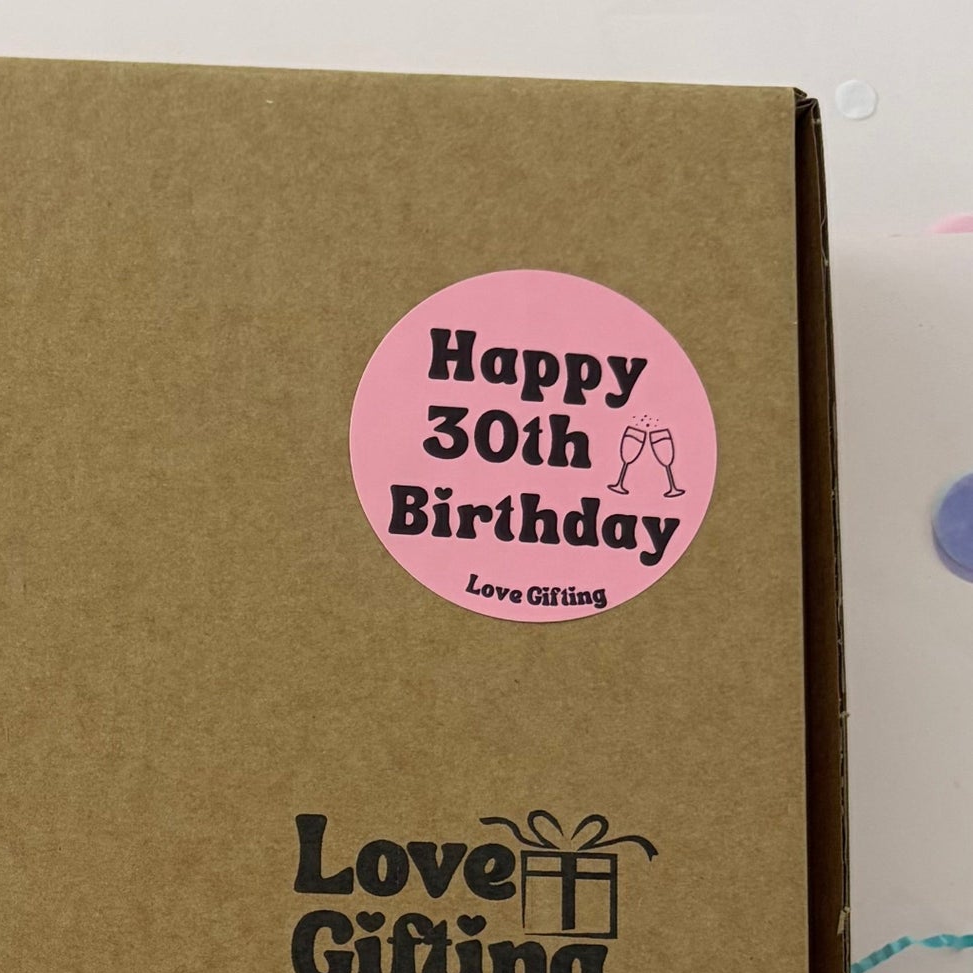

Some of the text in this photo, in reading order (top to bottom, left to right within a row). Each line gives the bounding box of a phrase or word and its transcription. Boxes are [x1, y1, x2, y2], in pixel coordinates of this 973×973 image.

[428, 328, 647, 409] Happy
[423, 405, 592, 469] 30th
[388, 484, 680, 567] Birthday
[466, 574, 608, 609] Love Gifting
[293, 813, 517, 901] Love
